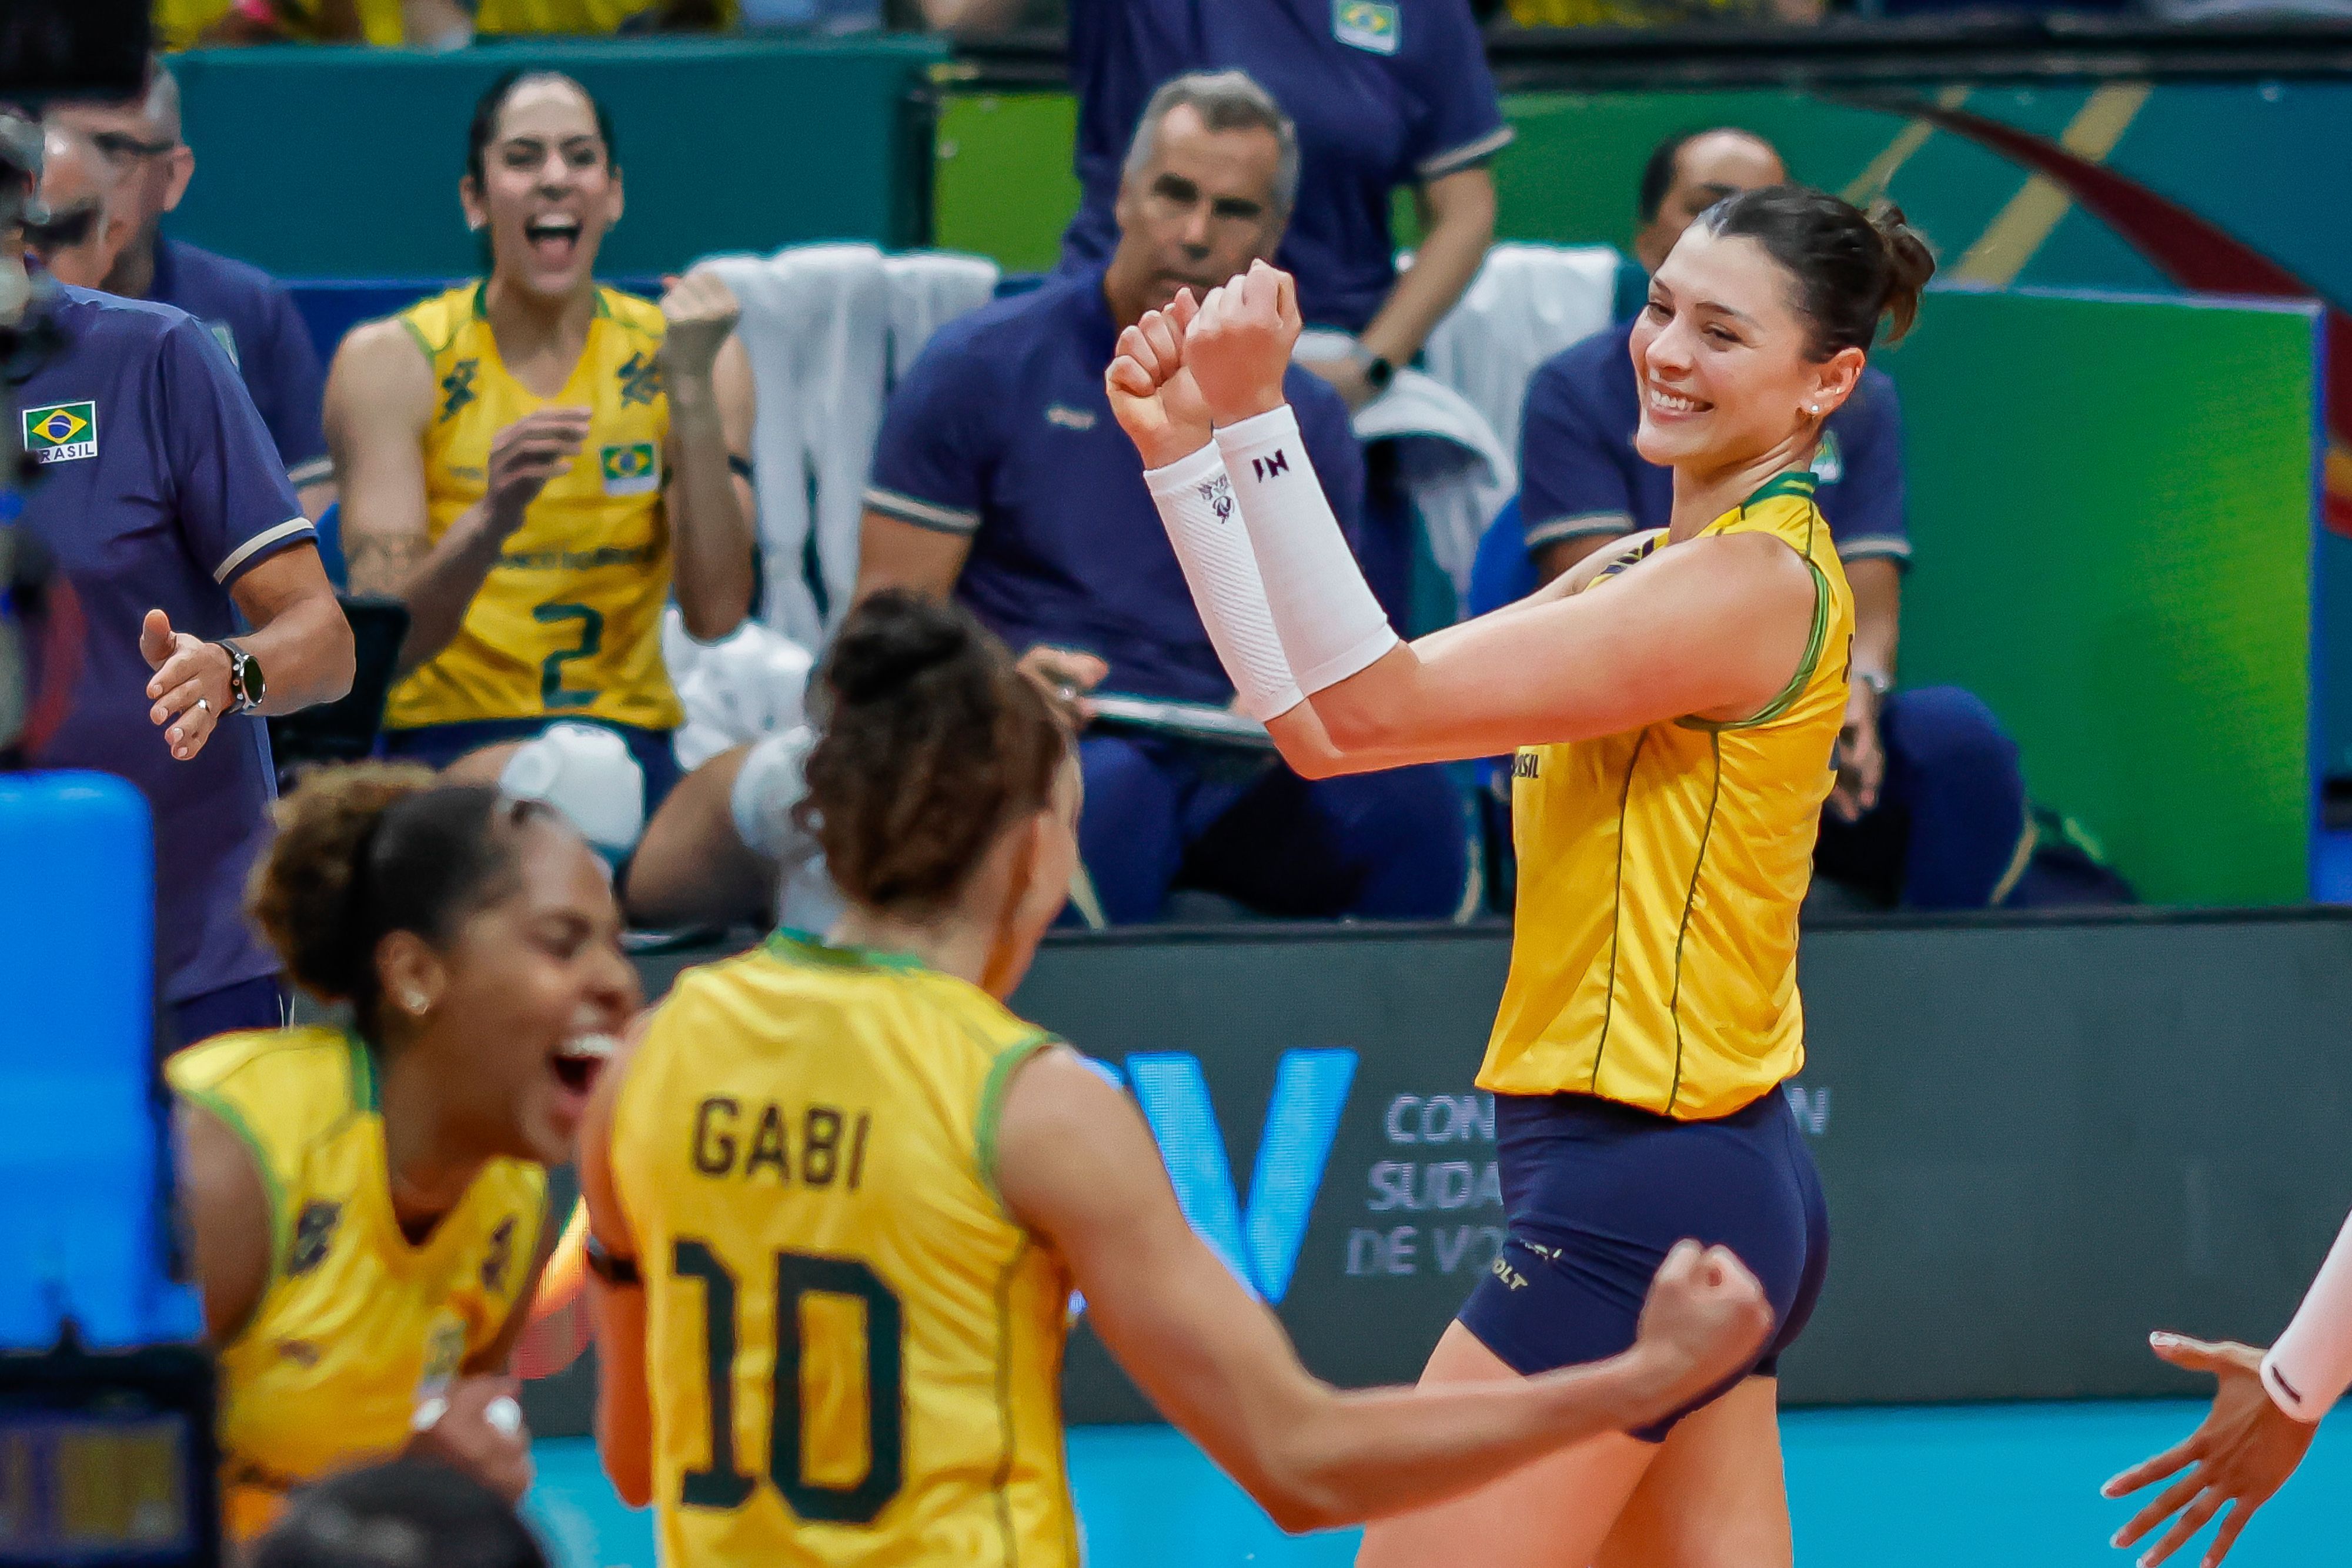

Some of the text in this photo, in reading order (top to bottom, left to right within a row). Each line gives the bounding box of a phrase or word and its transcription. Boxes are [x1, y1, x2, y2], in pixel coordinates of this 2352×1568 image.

[40, 444, 95, 463] RASIL
[533, 602, 604, 708] 2
[691, 1094, 871, 1192] GABI
[1345, 1225, 1418, 1275] DE
[673, 1235, 903, 1524] 10
